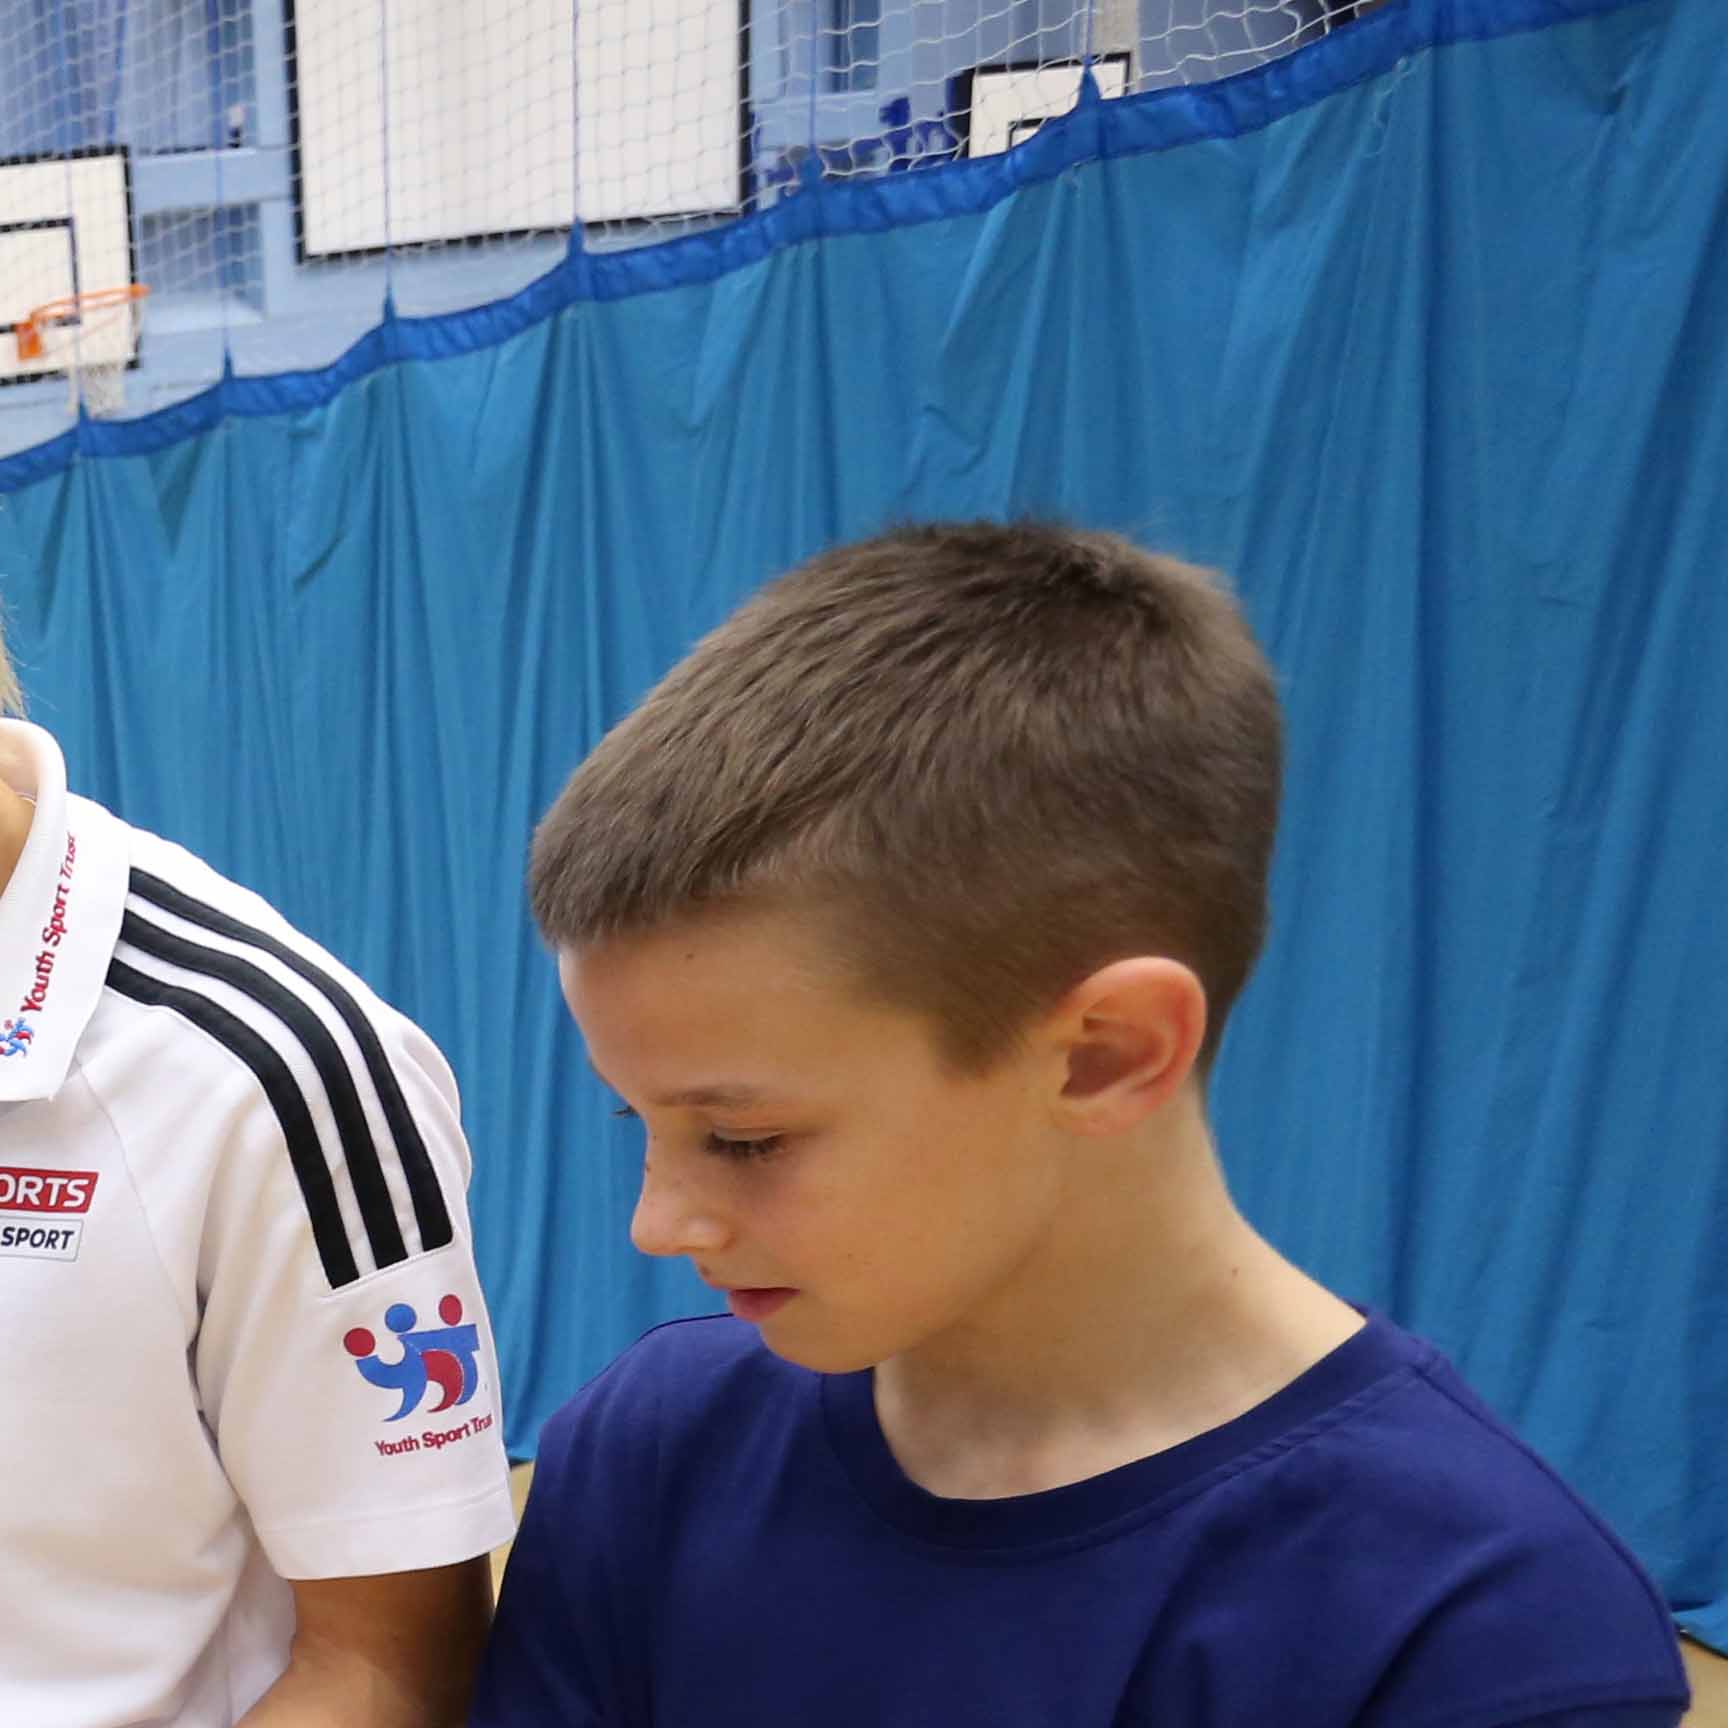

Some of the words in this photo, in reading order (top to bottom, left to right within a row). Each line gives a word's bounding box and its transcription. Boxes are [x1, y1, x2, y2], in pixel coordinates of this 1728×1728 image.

[20, 950, 55, 1012] Youth
[42, 884, 70, 947] Sport
[0, 1226, 75, 1251] SPORT
[375, 1435, 420, 1456] Youth
[421, 1423, 470, 1449] Sport
